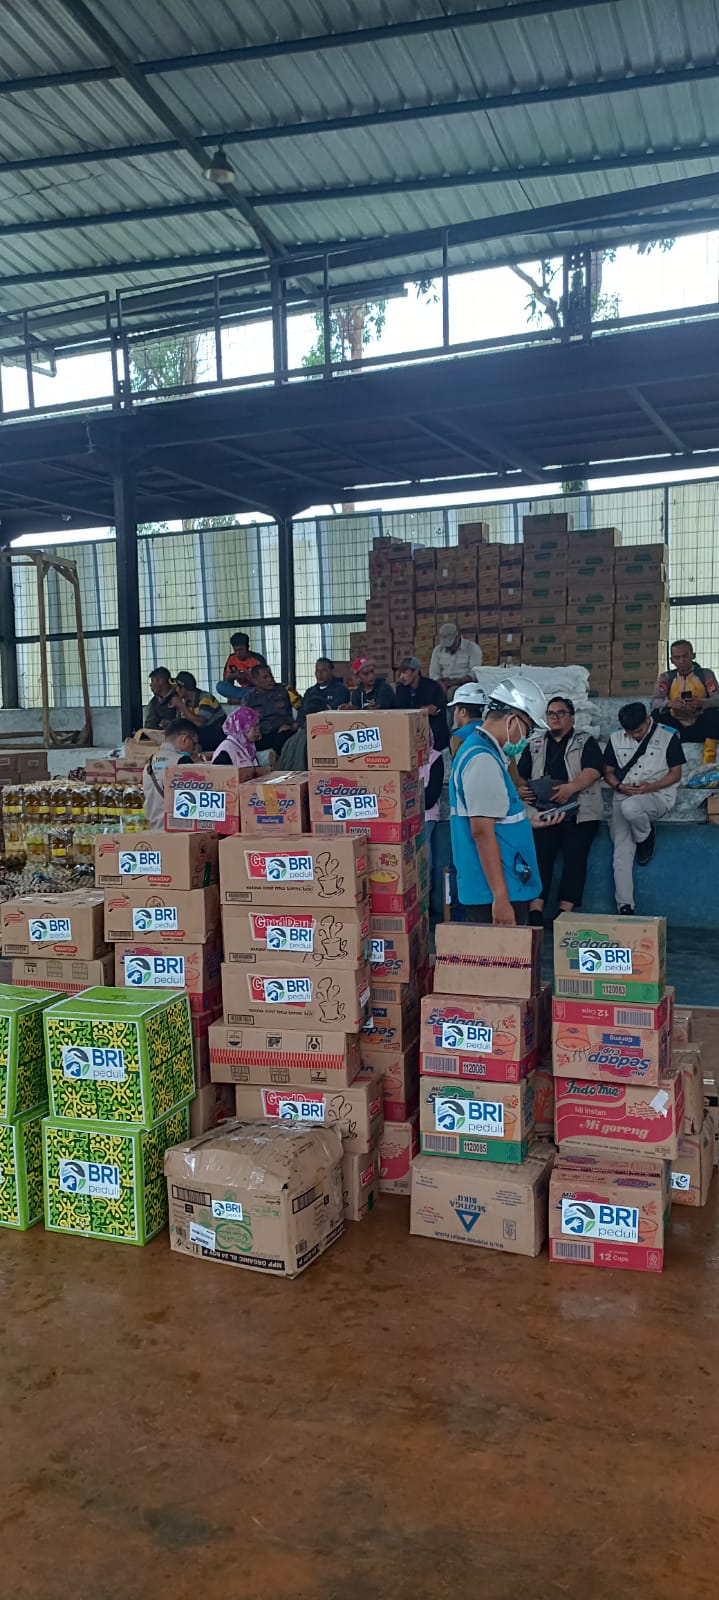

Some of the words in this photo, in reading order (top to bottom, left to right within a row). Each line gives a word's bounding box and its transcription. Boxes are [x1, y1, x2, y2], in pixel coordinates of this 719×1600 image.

[357, 728, 379, 743] BRI
[170, 778, 213, 791] Sedaap
[199, 792, 224, 808] BRI
[354, 796, 377, 808] BRI
[140, 853, 160, 864] BRI
[289, 858, 311, 870] BRI
[155, 908, 176, 921] BRI
[50, 920, 70, 932] BRI
[290, 928, 312, 942] BRI
[370, 940, 383, 952] RI
[605, 950, 630, 963] BRI
[154, 958, 183, 974] BRI
[154, 974, 184, 985] peduli
[287, 980, 309, 992] BRI
[468, 1028, 492, 1042] BRI
[92, 1049, 123, 1068] BRI
[588, 1052, 651, 1070] Sedaap
[93, 1068, 124, 1079] peduli
[302, 1104, 322, 1116] BRI
[468, 1102, 502, 1122] BRI
[584, 1107, 606, 1116] Instan
[468, 1122, 504, 1133] peduli
[602, 1124, 649, 1140] goreng
[88, 1164, 118, 1184] BRI
[88, 1184, 120, 1196] peduli
[458, 1194, 477, 1203] BIRU
[225, 1204, 241, 1212] BRI
[450, 1200, 486, 1213] SEGITIGA
[600, 1206, 636, 1228] BRI
[598, 1226, 637, 1239] peduli
[239, 1256, 267, 1266] ORGANIC
[598, 1253, 612, 1261] 12
[612, 1254, 629, 1262] Cups
